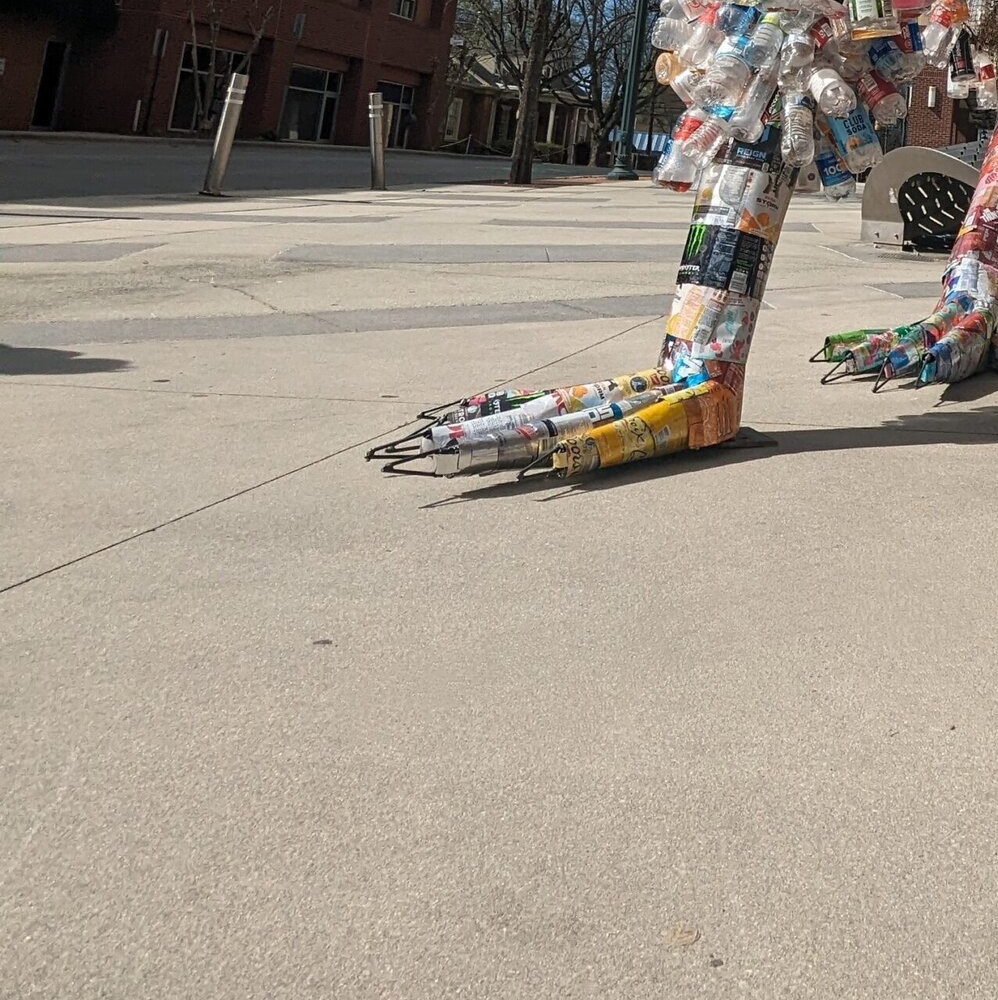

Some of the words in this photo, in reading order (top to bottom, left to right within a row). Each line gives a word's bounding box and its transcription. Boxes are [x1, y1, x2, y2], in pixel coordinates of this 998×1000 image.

[843, 114, 865, 129] CLUB
[846, 123, 867, 136] SODA
[736, 146, 767, 160] REIGN
